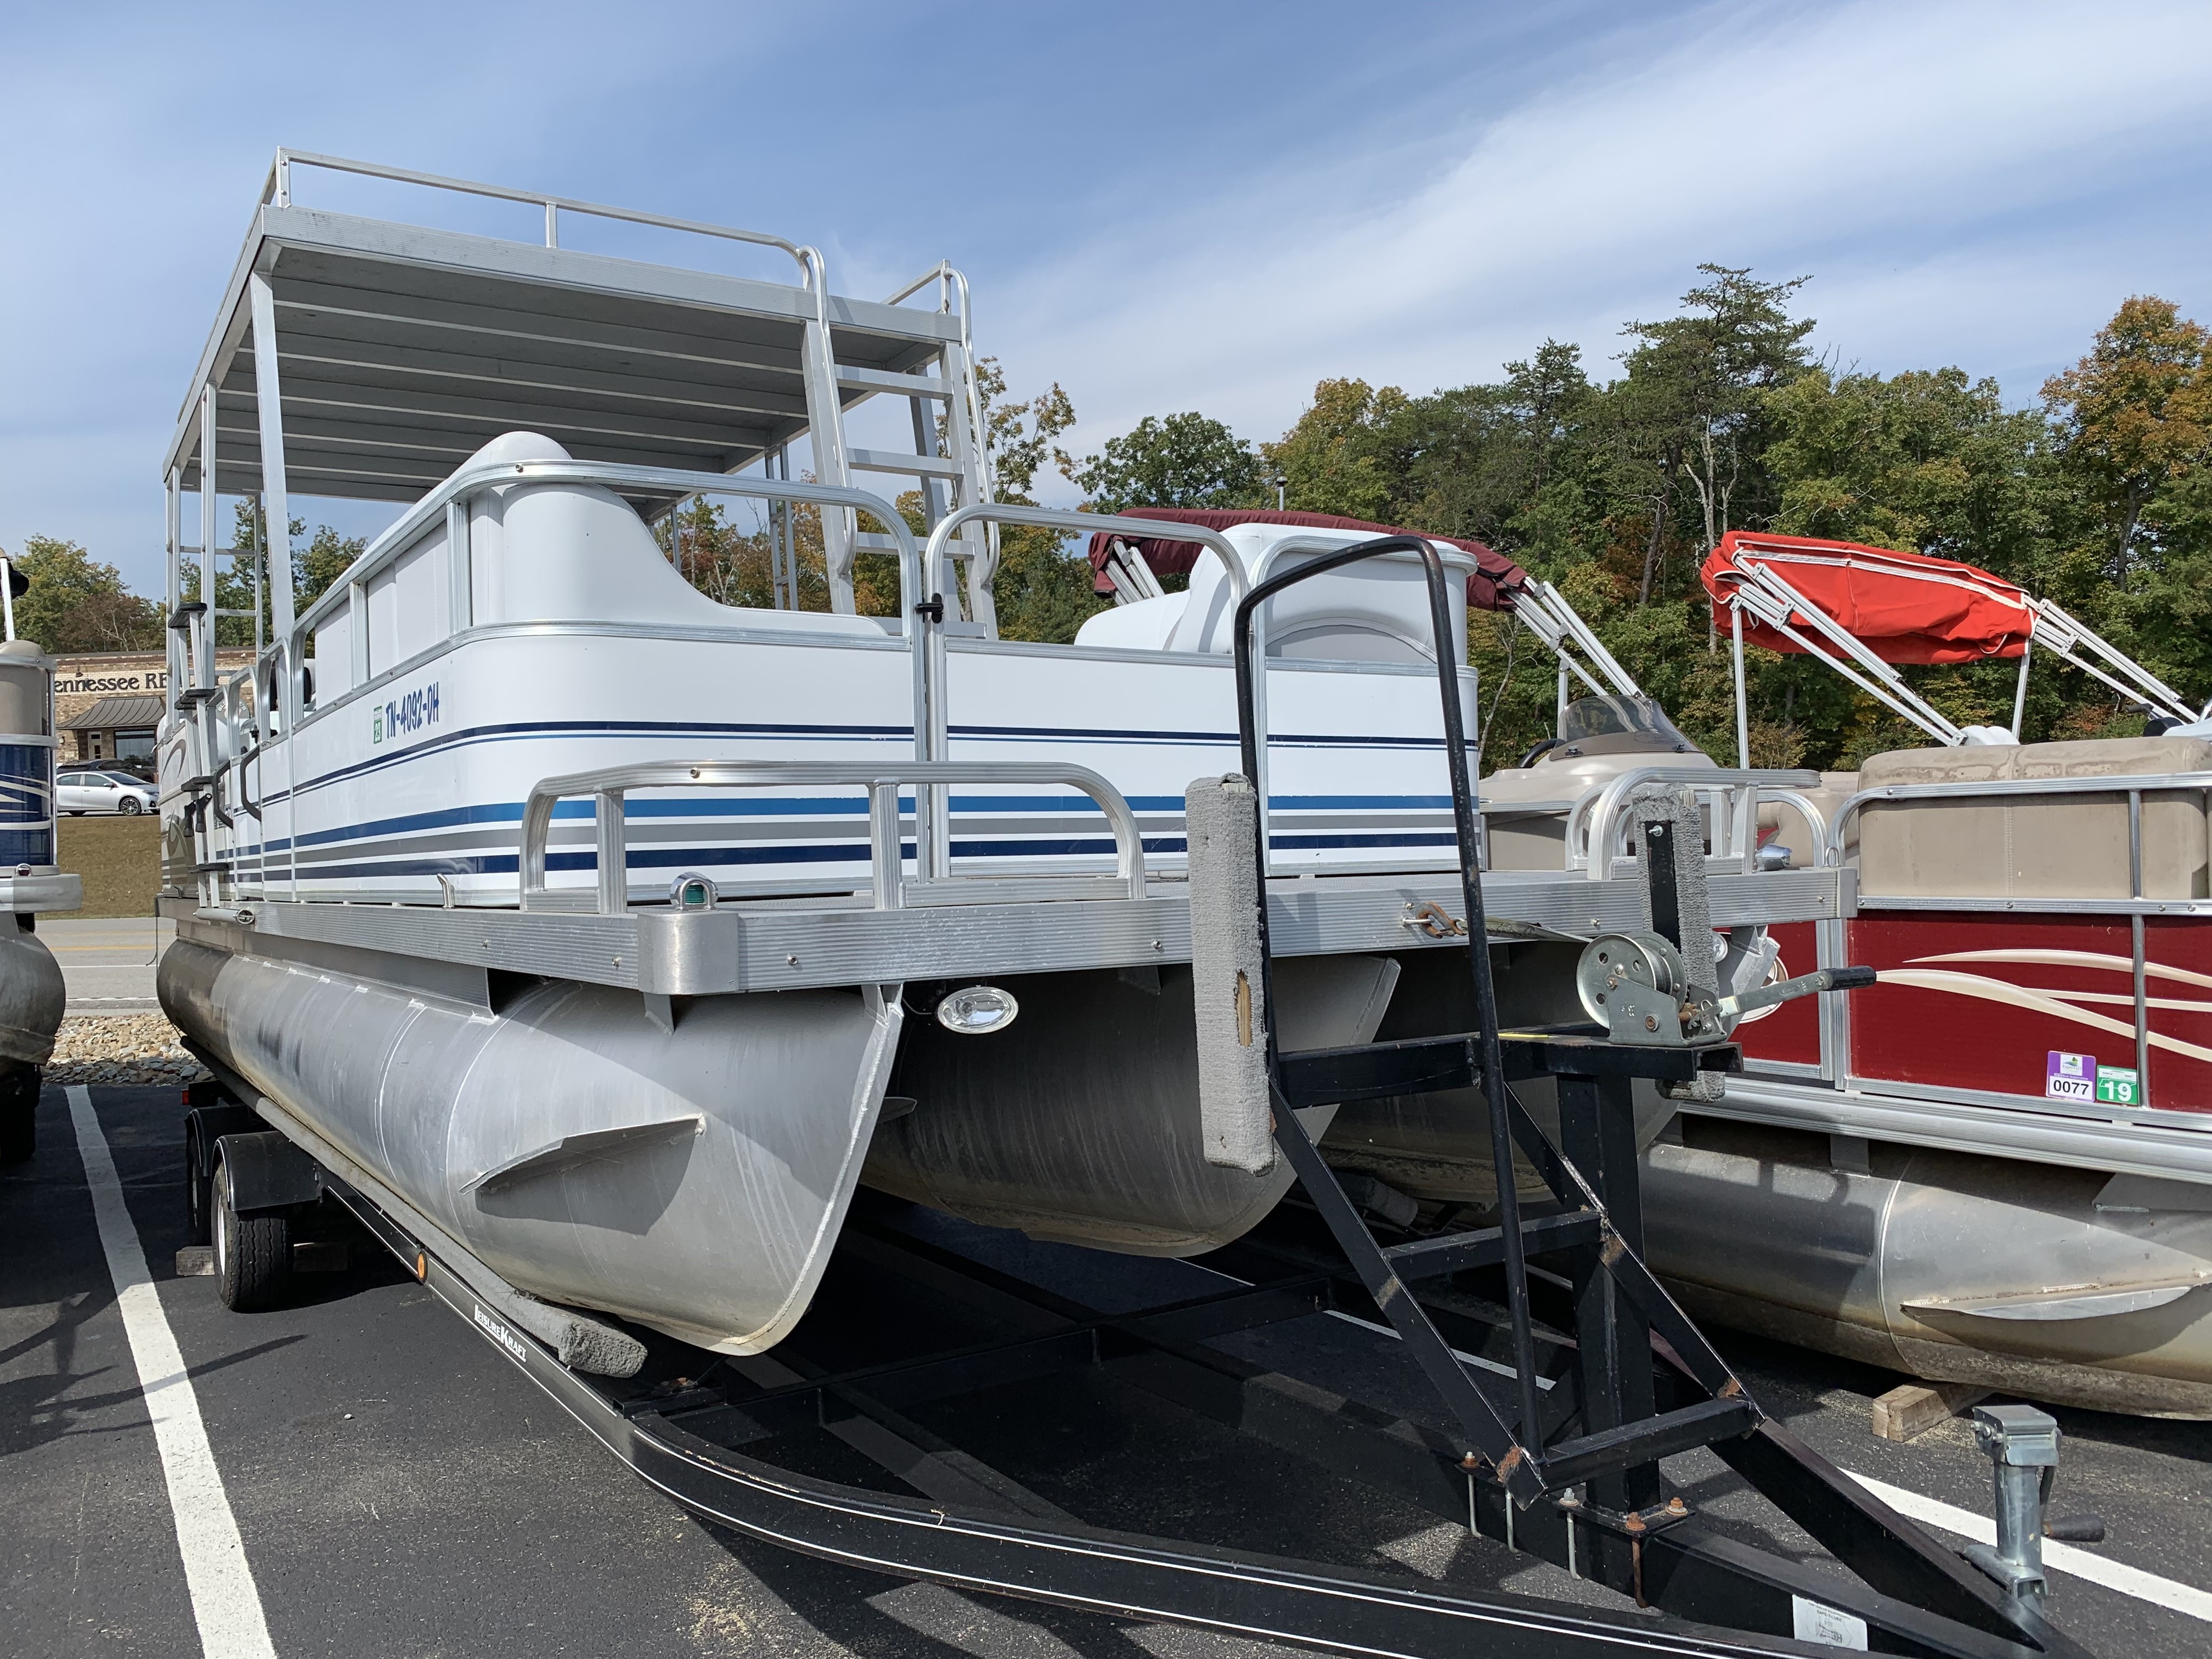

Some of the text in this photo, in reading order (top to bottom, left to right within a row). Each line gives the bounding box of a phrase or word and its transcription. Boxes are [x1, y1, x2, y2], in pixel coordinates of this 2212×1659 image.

[55, 676, 139, 692] ennessee
[375, 722, 381, 742] 23
[2053, 1080, 2089, 1095] 0077
[2104, 1081, 2132, 1102] 19
